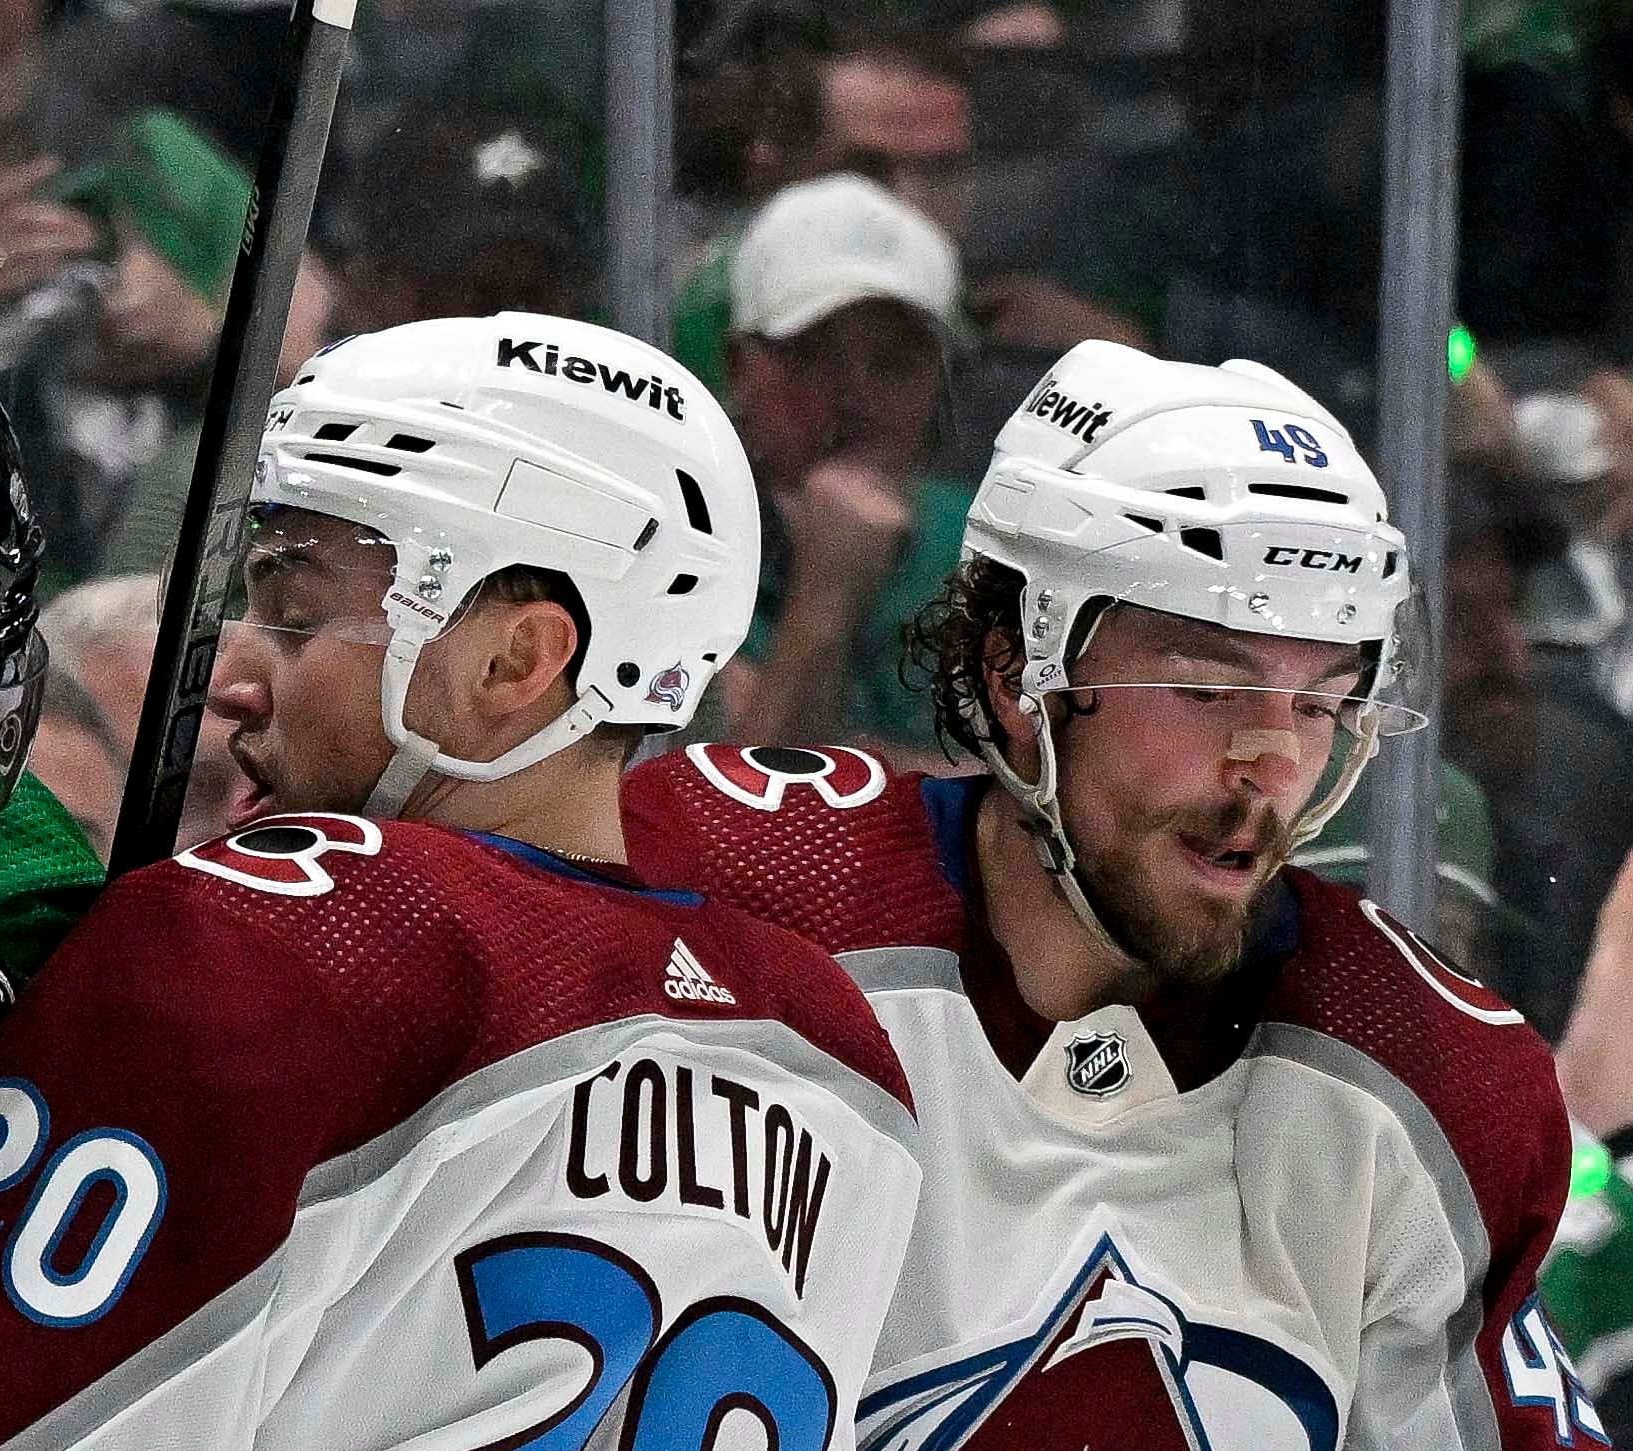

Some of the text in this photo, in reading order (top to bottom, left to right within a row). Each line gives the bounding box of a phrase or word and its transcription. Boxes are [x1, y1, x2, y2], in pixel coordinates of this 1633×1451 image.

[496, 337, 684, 421] Kiewit
[1249, 418, 1328, 468] 49
[1263, 546, 1363, 574] CCM
[664, 978, 736, 1005] adidas
[1079, 1050, 1119, 1085] NHL
[566, 1057, 831, 1302] COLTON
